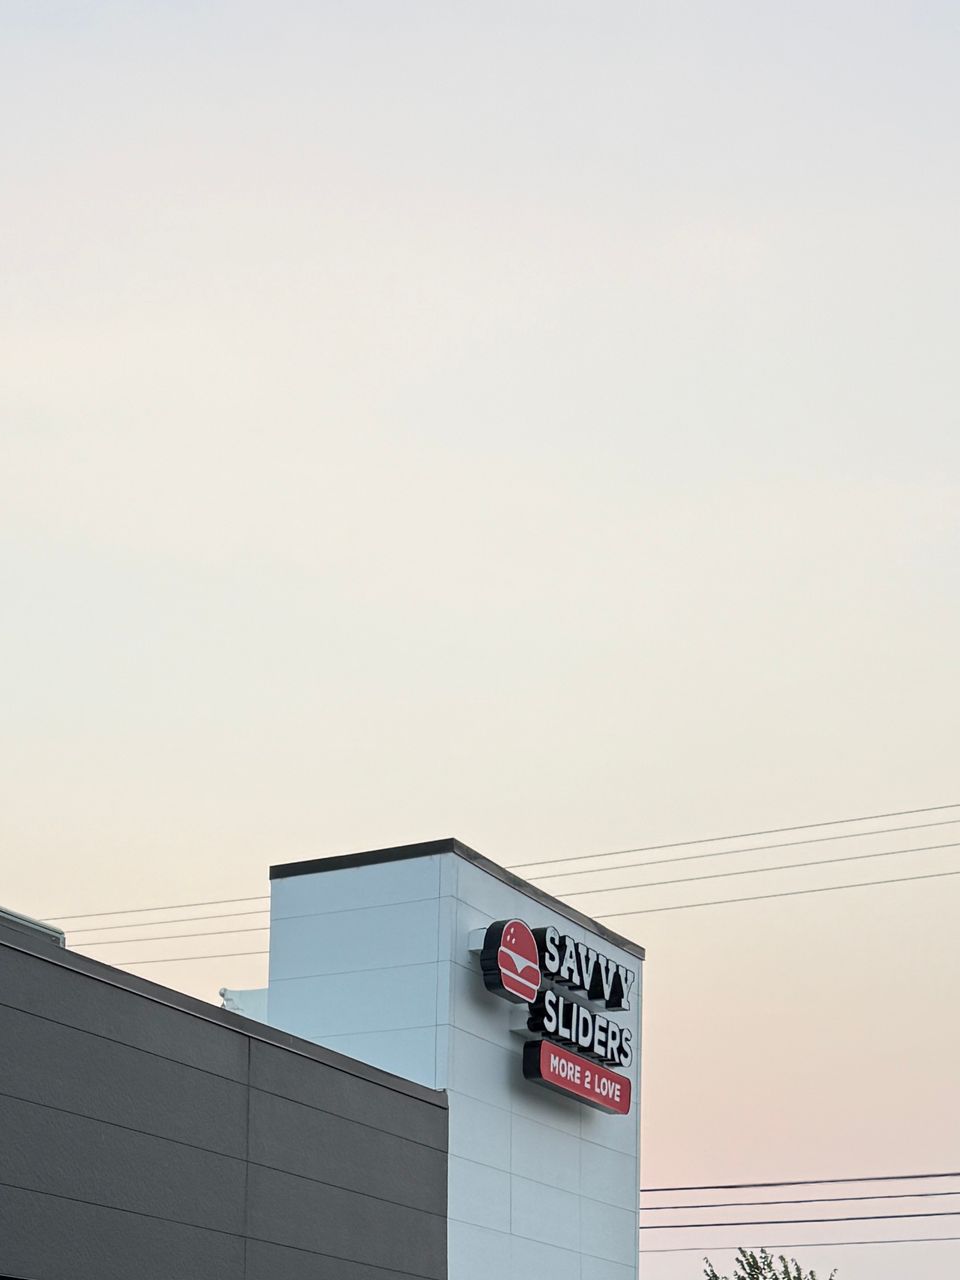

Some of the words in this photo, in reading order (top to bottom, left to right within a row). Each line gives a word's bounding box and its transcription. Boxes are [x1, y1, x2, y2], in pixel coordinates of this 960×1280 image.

[545, 925, 635, 1011] SAVVY
[543, 990, 632, 1068] SLIDERS
[550, 1053, 581, 1085] MORE
[584, 1071, 591, 1089] 2
[594, 1074, 621, 1102] LOVE
